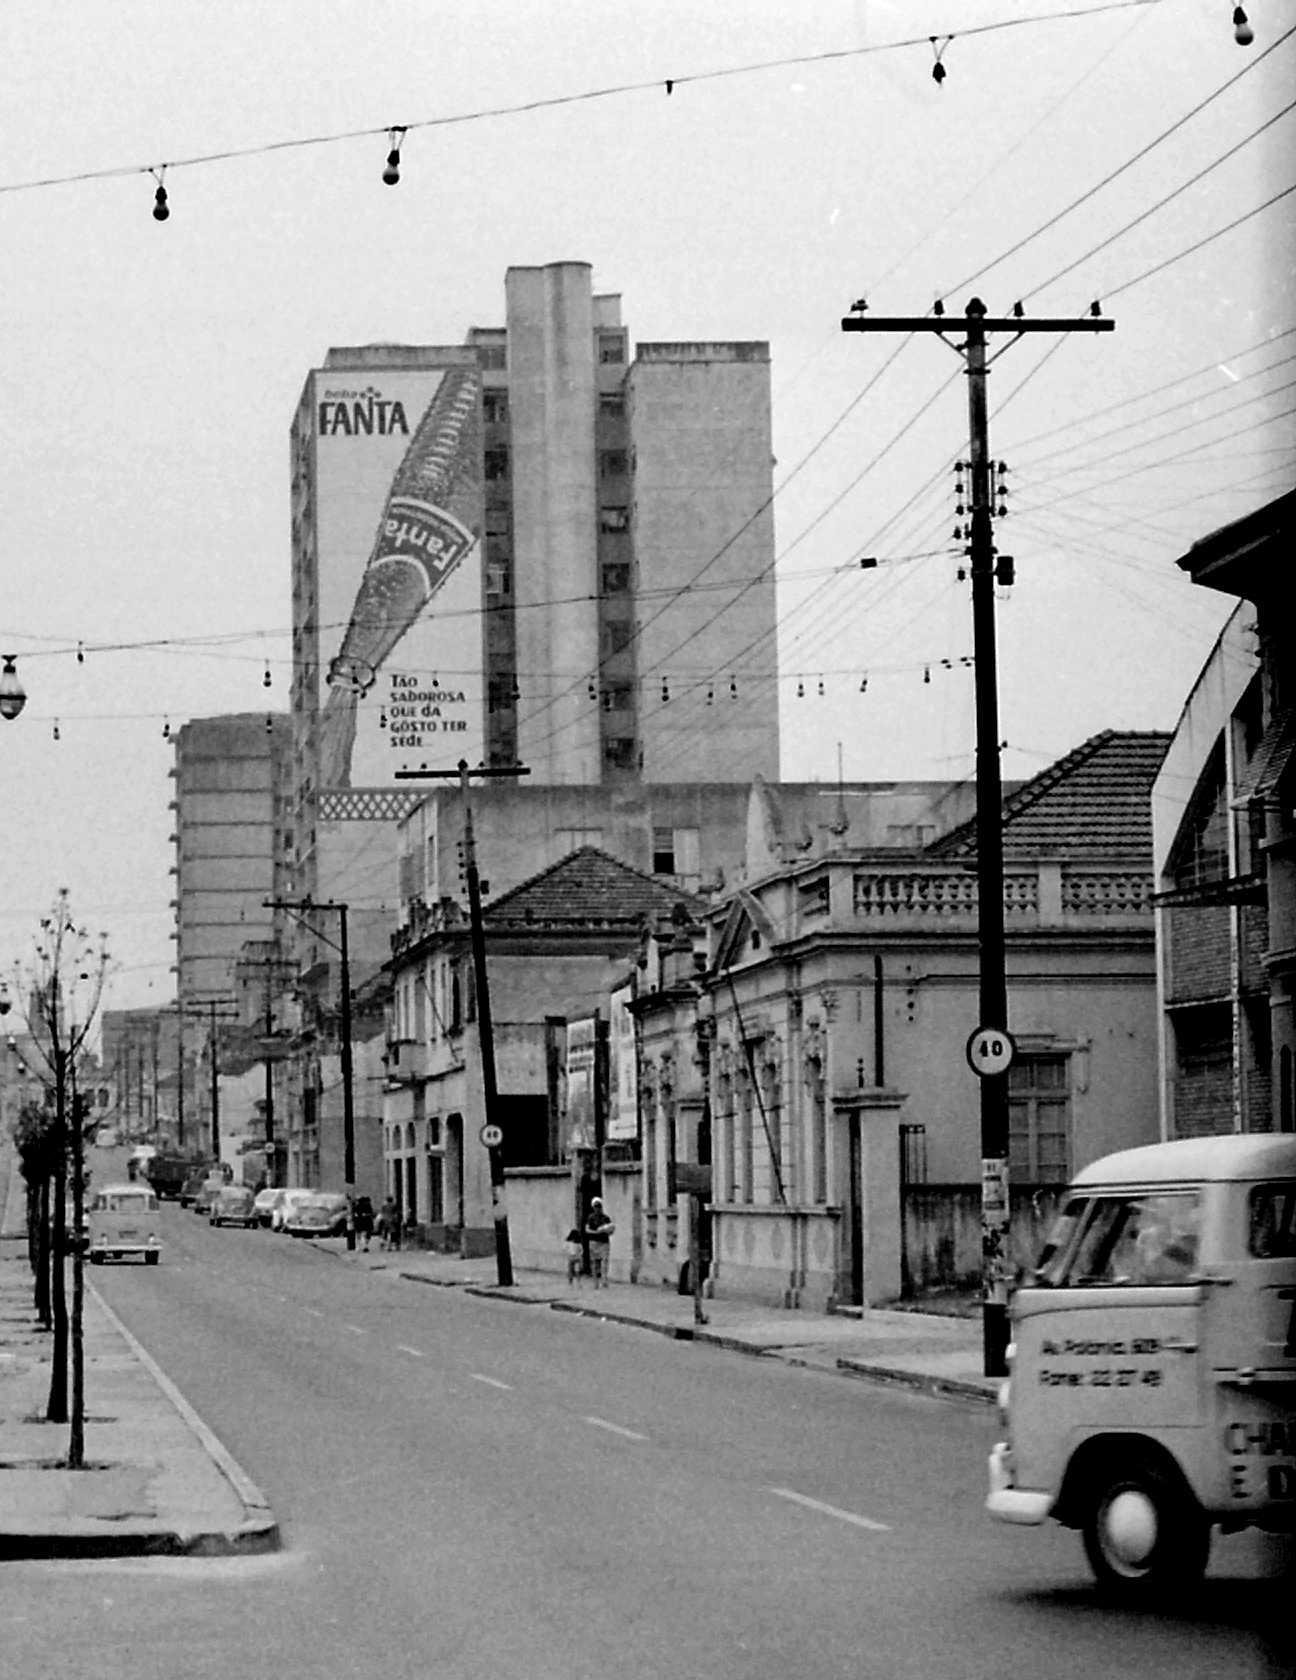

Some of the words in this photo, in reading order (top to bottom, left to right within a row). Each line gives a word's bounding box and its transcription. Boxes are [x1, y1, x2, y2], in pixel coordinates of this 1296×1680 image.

[318, 396, 410, 436] FANTA
[385, 518, 459, 571] Fanta
[441, 720, 467, 732] TER
[979, 1040, 1003, 1057] 40
[1230, 1465, 1252, 1497] E
